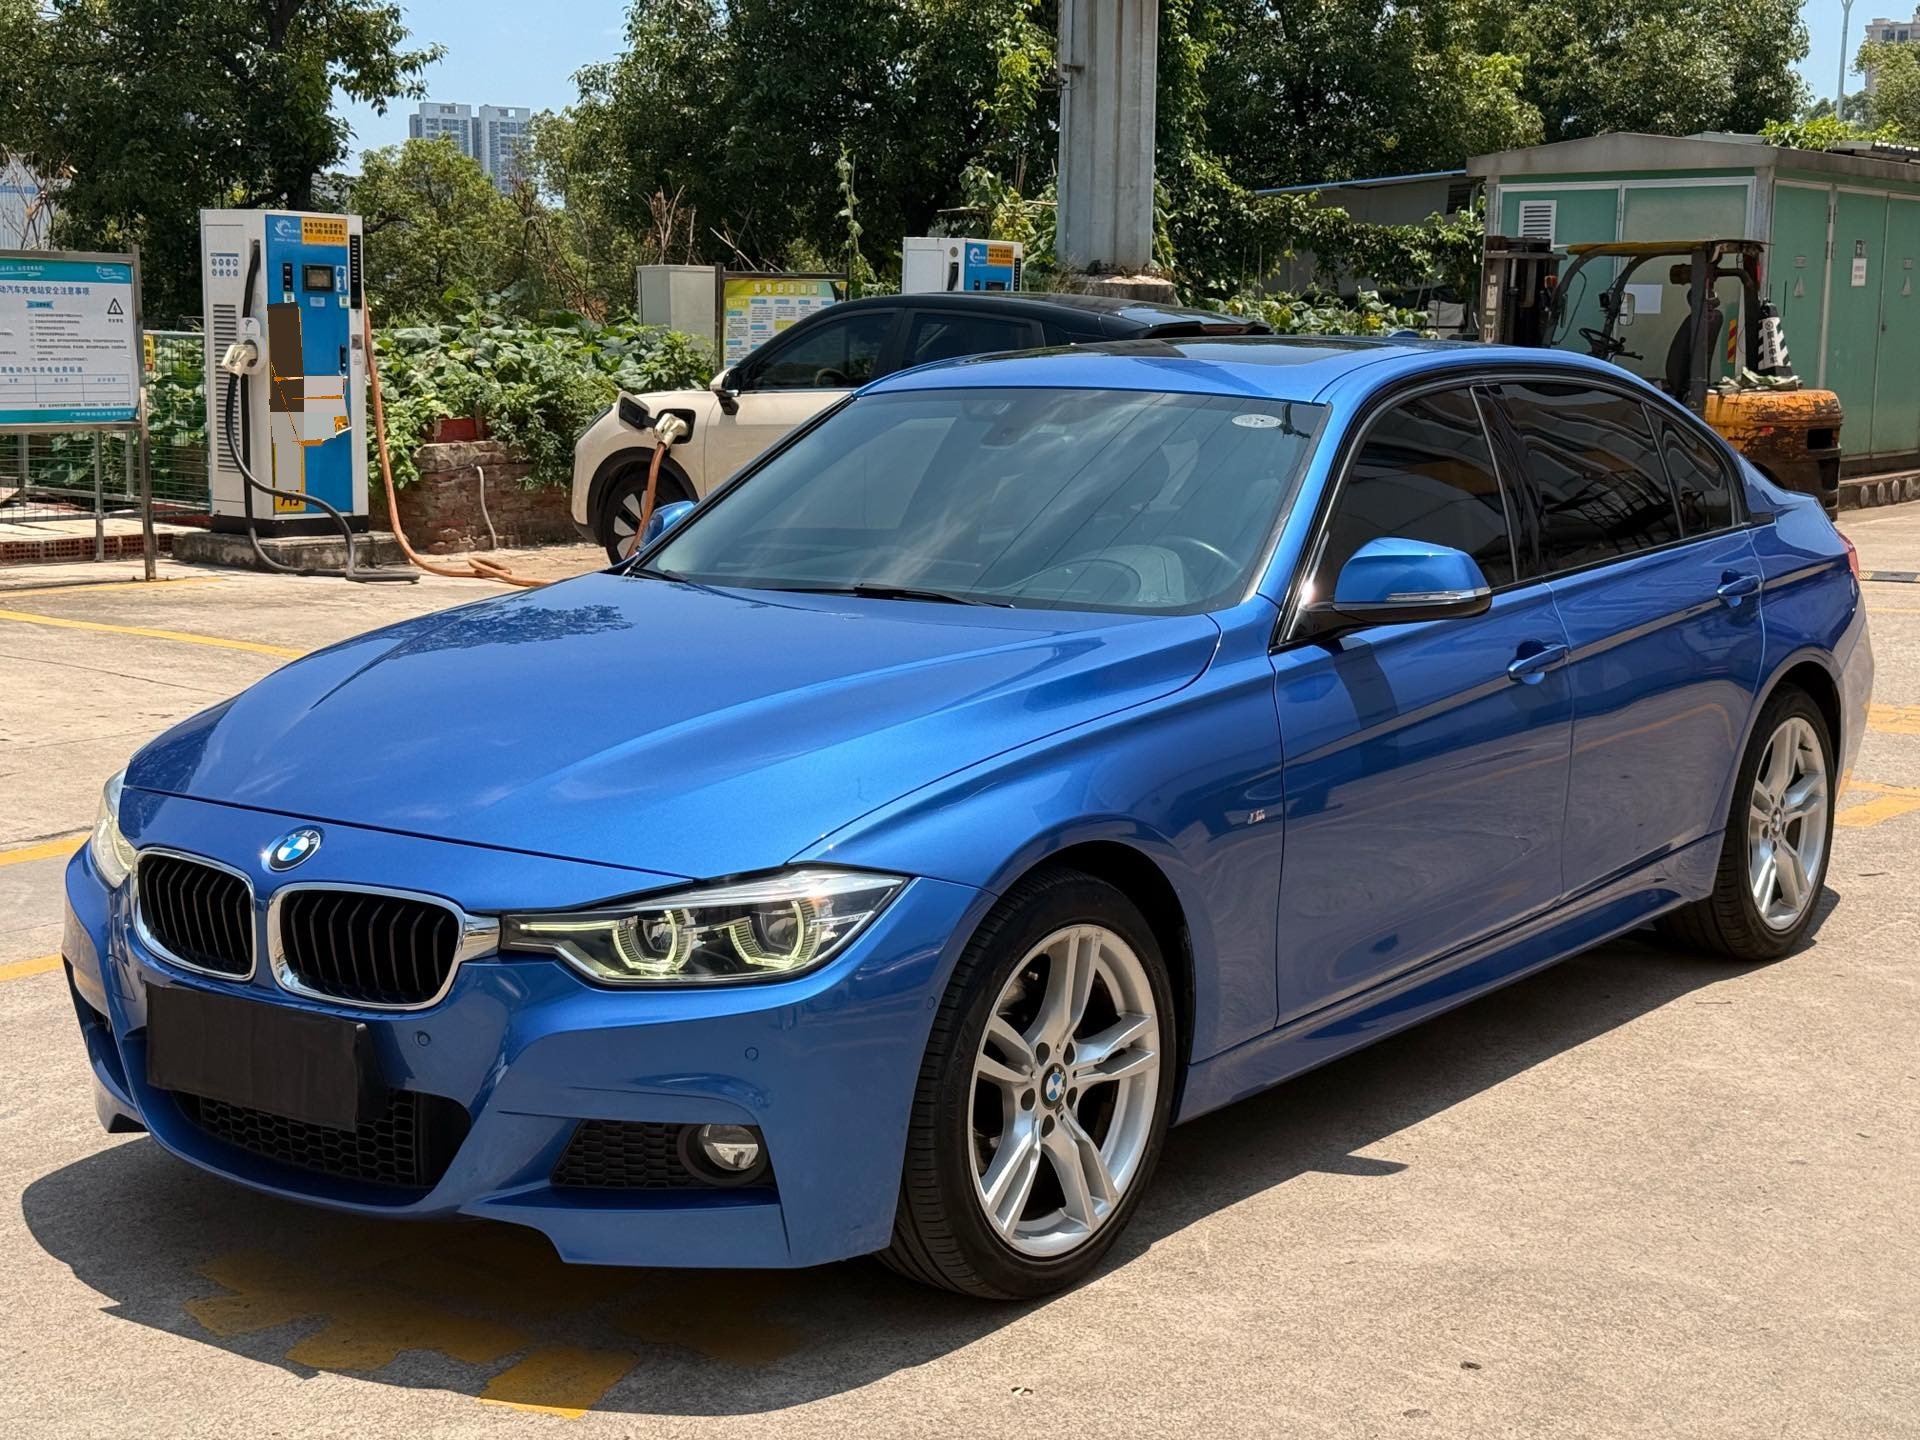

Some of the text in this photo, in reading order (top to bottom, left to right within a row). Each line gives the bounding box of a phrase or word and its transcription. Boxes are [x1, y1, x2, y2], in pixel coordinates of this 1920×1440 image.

[0, 285, 90, 296] 动汽车充电站安全注意事项
